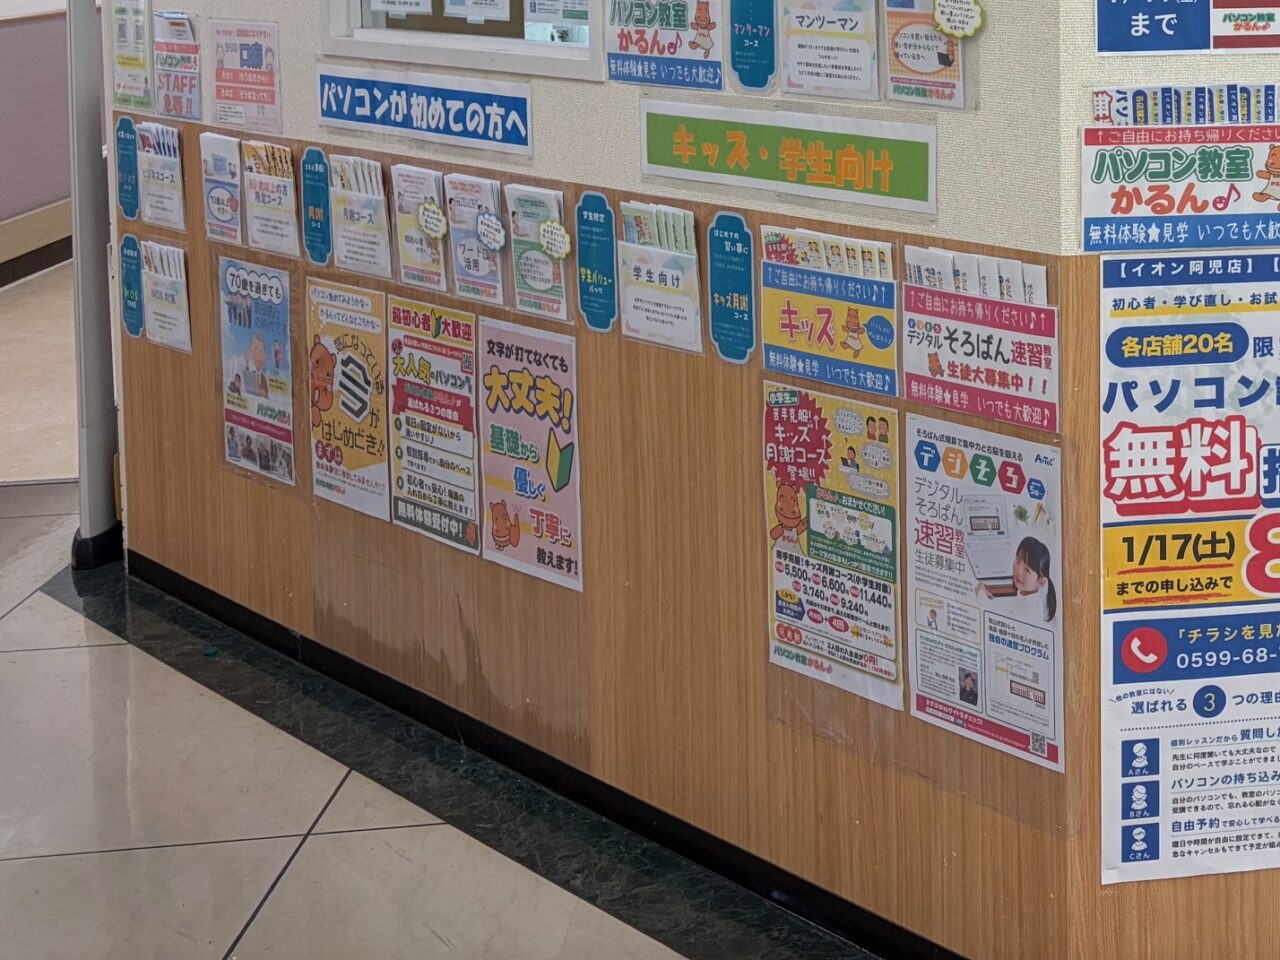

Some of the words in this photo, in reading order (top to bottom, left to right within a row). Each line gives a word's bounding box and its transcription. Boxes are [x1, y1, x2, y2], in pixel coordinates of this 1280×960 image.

[795, 13, 859, 31] マンツーマン
[1129, 12, 1177, 36] まで
[158, 74, 197, 91] STAFF
[322, 82, 526, 140] パソコンが初めての方へ
[672, 125, 894, 192] キッズ・学生向け
[1091, 145, 1253, 184] パソコン教室
[633, 266, 680, 289] 学生向け
[1116, 257, 1256, 279] 【イオン阿児店】
[230, 274, 281, 299] 70歳を過ぎても
[392, 306, 430, 331] 超初心者
[442, 318, 472, 341] 大歓迎
[780, 300, 836, 350] キッズ
[907, 330, 943, 349] デジタル
[1121, 332, 1234, 358] 各店舗20名
[487, 339, 569, 373] 文字が打てなくても
[483, 365, 573, 432] 大丈夫!
[490, 423, 539, 464] 基礎から
[774, 423, 813, 444] キッズ
[767, 443, 828, 465] 月謝コース
[1104, 415, 1261, 500] 無料
[513, 466, 546, 501] 優しく
[914, 476, 963, 504] デジタル
[915, 497, 963, 525] そろばん
[530, 507, 572, 547] 丁寧に
[914, 517, 953, 555] 速習
[914, 548, 965, 575] 生徒募集中
[1121, 530, 1236, 566] 1/17(土)
[1116, 575, 1233, 596] までの申し込みで
[1131, 698, 1187, 715] 選ばれる
[1204, 693, 1216, 712] 3
